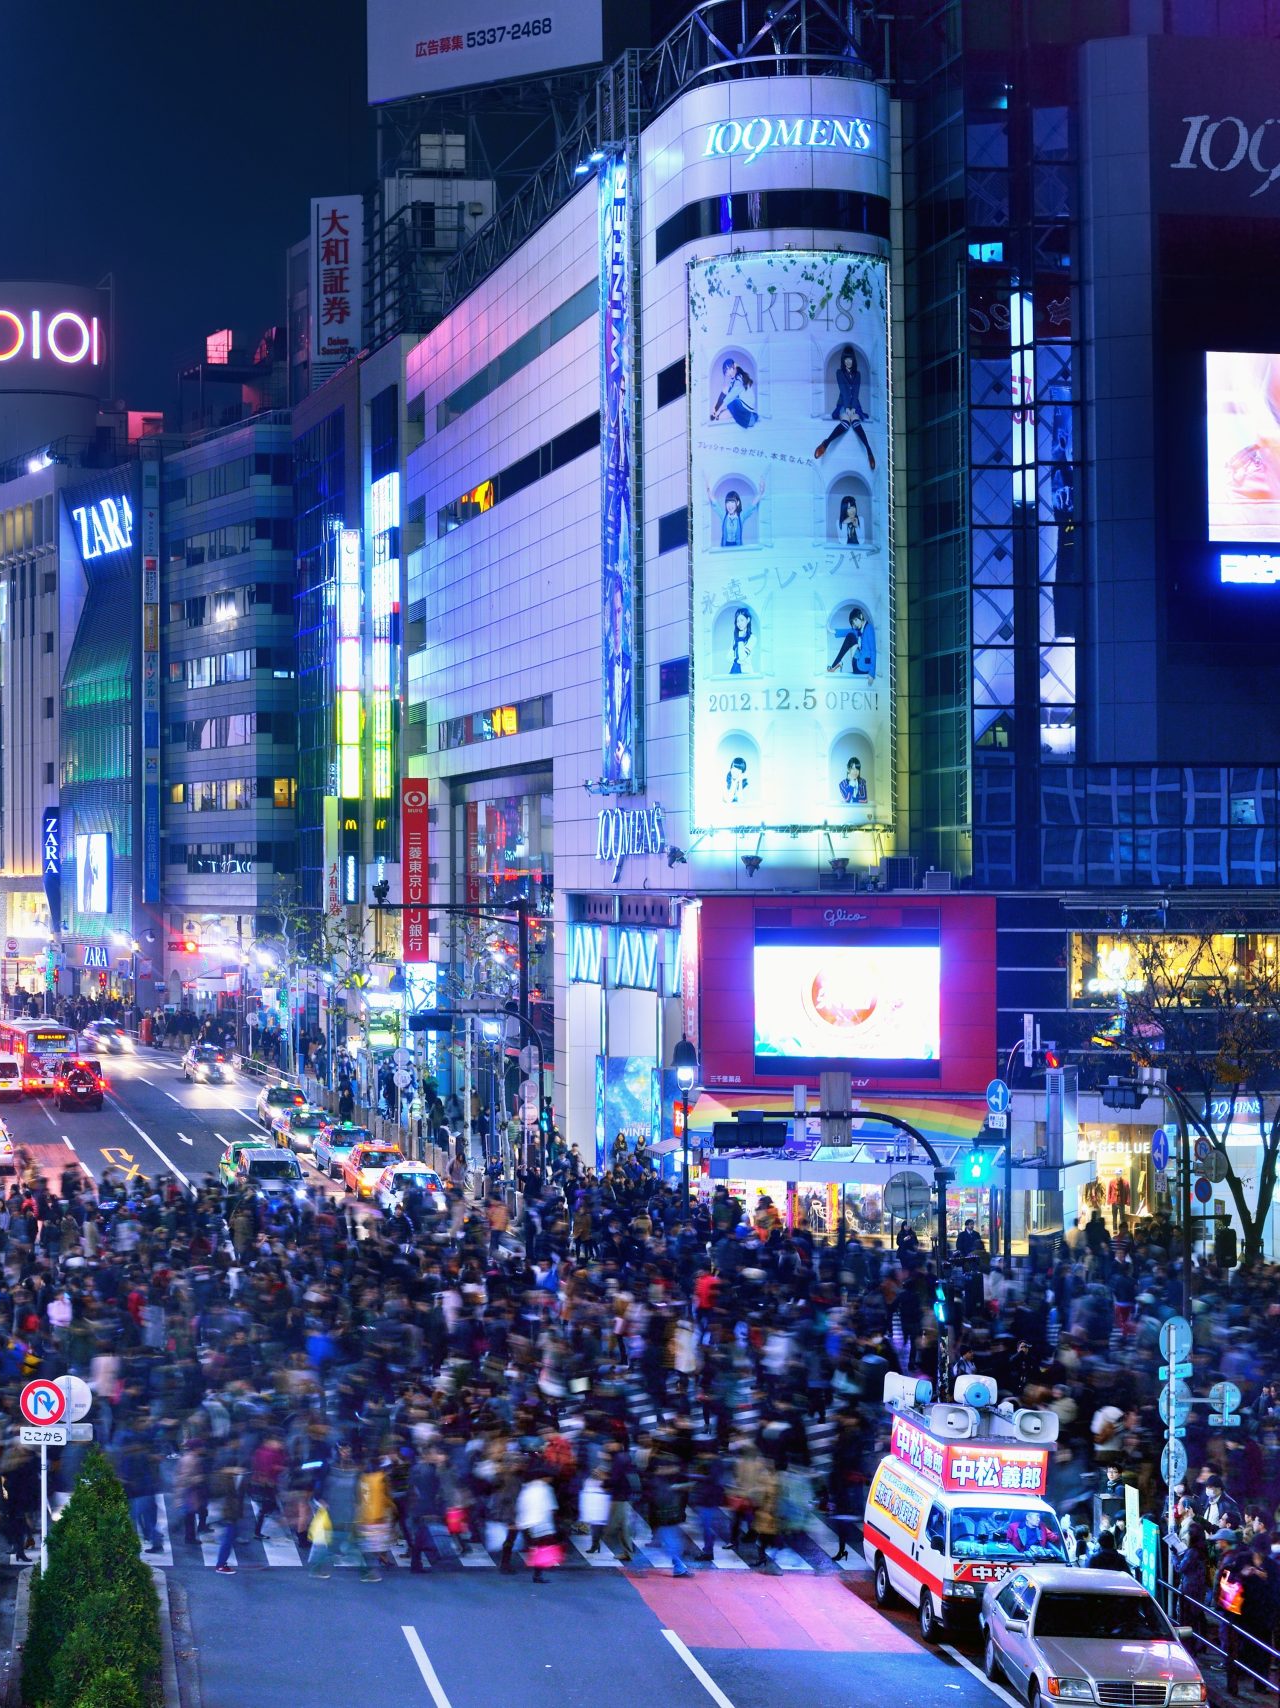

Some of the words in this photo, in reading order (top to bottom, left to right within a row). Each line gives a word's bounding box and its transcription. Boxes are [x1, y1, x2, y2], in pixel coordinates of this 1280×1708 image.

[415, 35, 463, 57] 広告募集
[466, 17, 552, 48] 5337-2468
[321, 208, 351, 326] 大和証券
[726, 291, 855, 336] AKB48
[72, 494, 133, 559] ZARA
[708, 688, 818, 713] 2012.12.5
[825, 691, 879, 711] OPEN!
[44, 818, 59, 874] ZARA
[824, 909, 867, 926] Glico
[84, 946, 108, 967] ZARA
[23, 1431, 63, 1442] ここから
[951, 1456, 1043, 1490] 中松義郎
